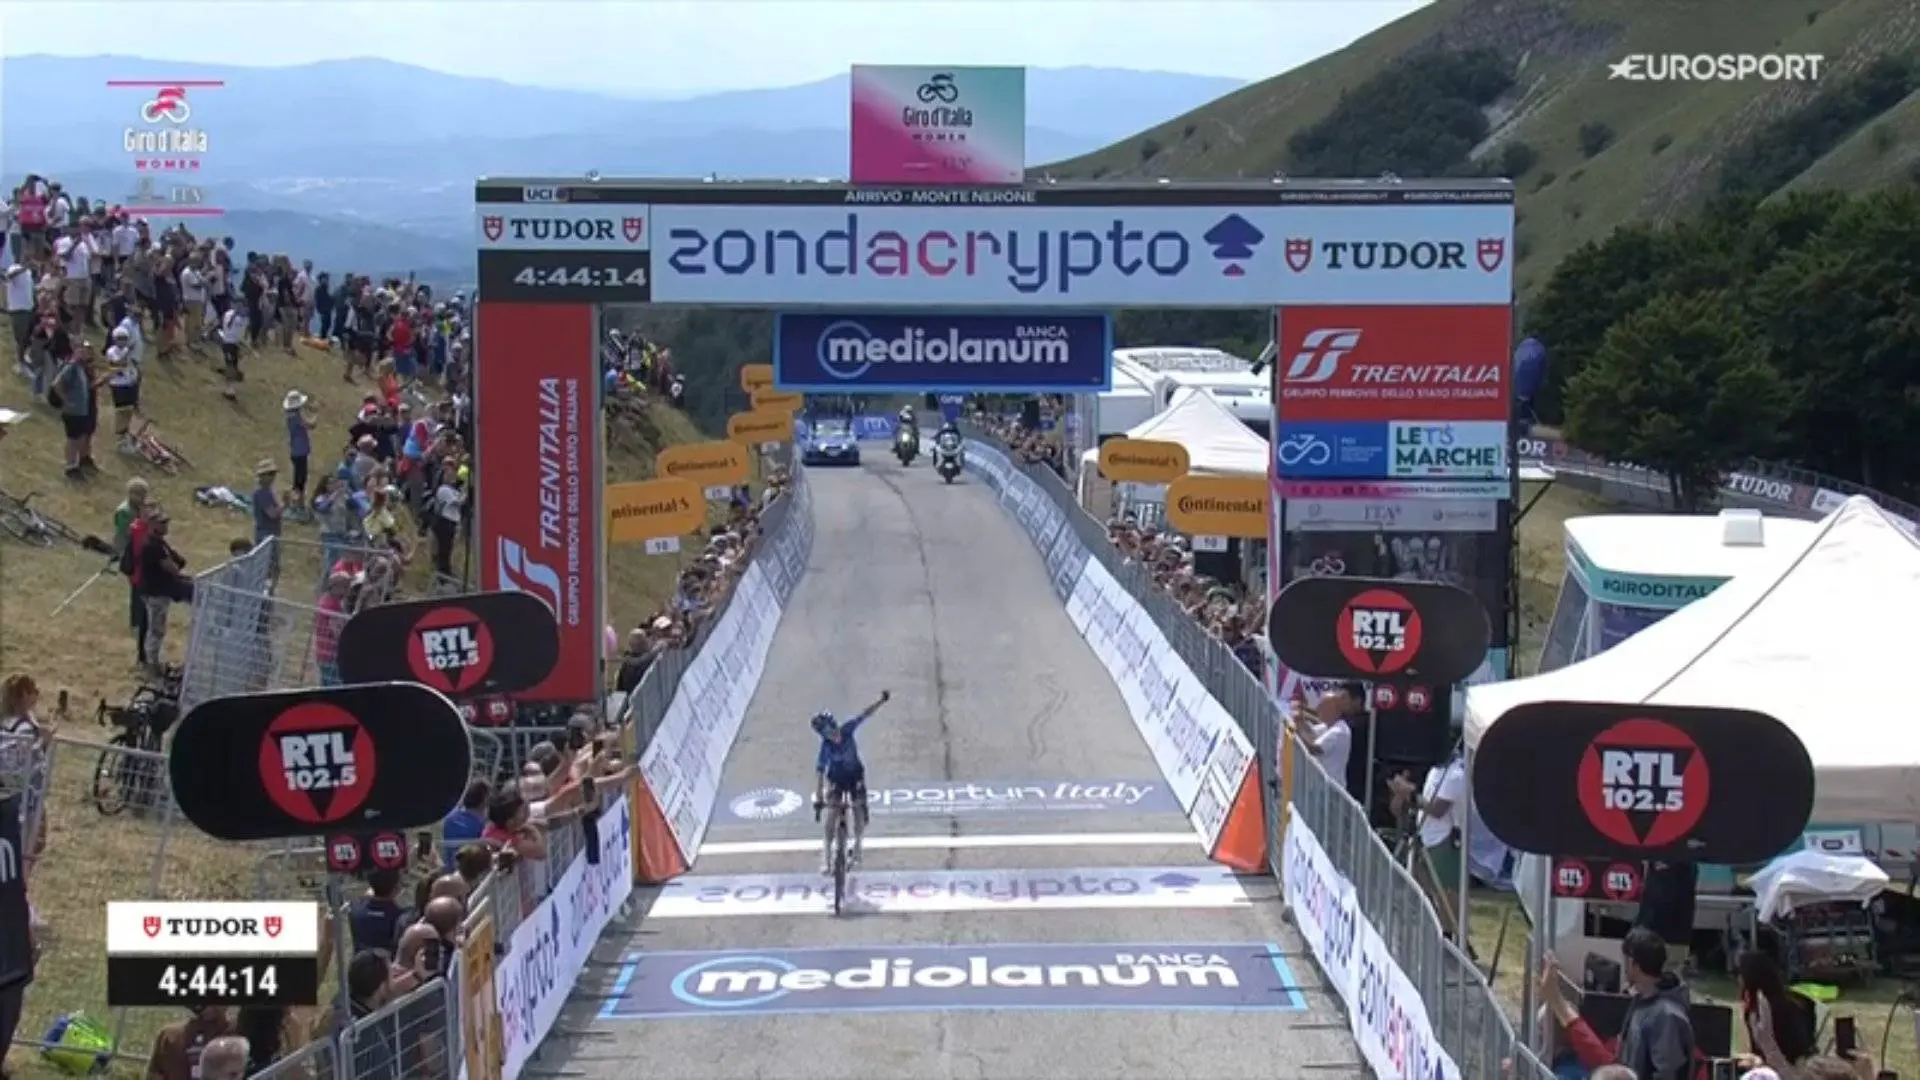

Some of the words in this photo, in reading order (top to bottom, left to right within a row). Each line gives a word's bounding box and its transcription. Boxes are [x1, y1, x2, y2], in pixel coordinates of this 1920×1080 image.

[902, 105, 929, 127] Giro
[528, 188, 553, 200] UCI
[845, 190, 903, 202] ARRIVO
[911, 190, 967, 202] MONTE
[972, 190, 1036, 202] NERONE
[511, 217, 616, 241] TUDOR
[668, 213, 1189, 293] zondacrypto
[1322, 241, 1467, 270] TUDOR
[514, 266, 648, 287] 4:44:14
[1016, 325, 1068, 338] BANCA
[828, 327, 1070, 364] mediolanum
[1351, 364, 1501, 383] TRENITALIA
[539, 377, 561, 549] TRENITALIA
[1729, 472, 1793, 502] TUDOR
[611, 501, 678, 519] ntinental
[1178, 494, 1263, 514] Continental
[566, 576, 579, 626] GRUPPO
[1353, 610, 1405, 634] RTL
[422, 627, 477, 654] RTL
[1353, 635, 1405, 651] 102.5
[425, 652, 480, 671] 102.5
[281, 731, 355, 769] RTL
[284, 766, 357, 792] 102.5
[1602, 750, 1684, 788] RTL
[1602, 788, 1684, 812] 102.5
[1116, 953, 1227, 966] BANCA
[697, 957, 1239, 993] mediolanum
